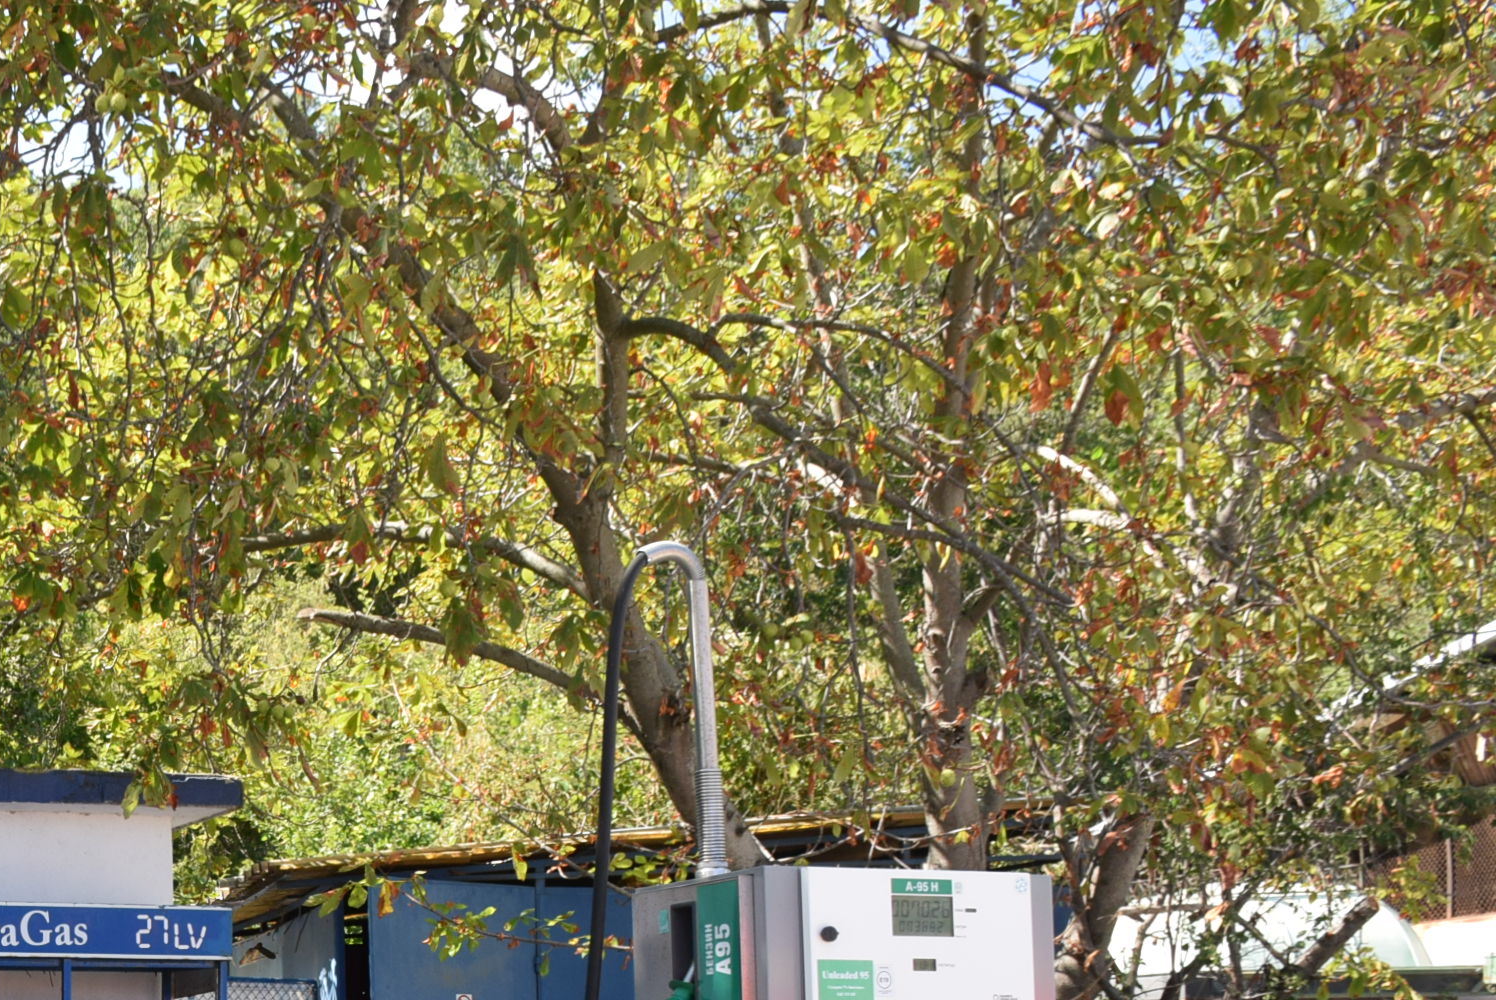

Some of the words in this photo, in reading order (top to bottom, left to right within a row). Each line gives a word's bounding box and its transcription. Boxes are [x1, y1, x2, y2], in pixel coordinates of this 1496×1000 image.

[704, 923, 714, 975] БЕНЗИН
[715, 923, 732, 975] А95
[822, 970, 858, 980] Unleaded
